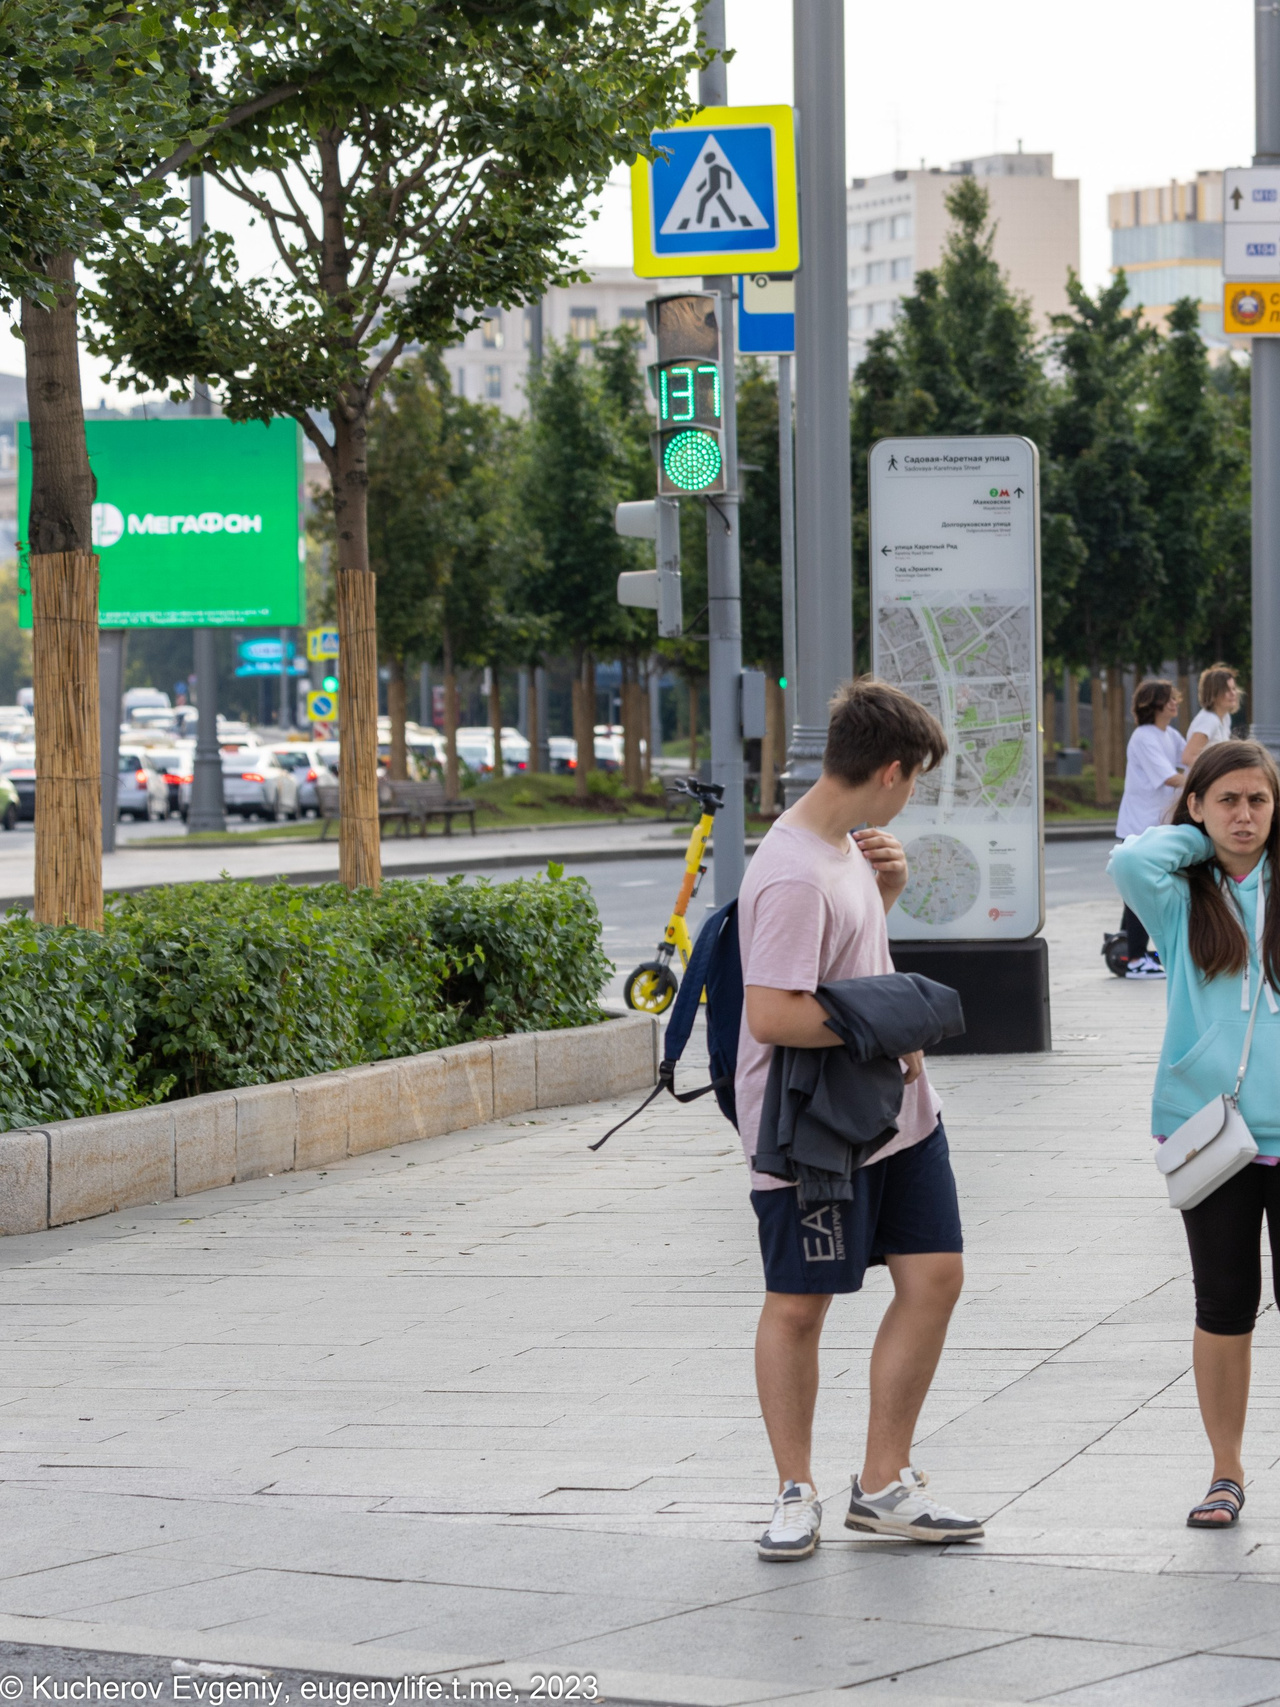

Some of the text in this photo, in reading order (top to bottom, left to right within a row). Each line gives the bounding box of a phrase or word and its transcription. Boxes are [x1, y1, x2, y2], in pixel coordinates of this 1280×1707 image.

[661, 366, 720, 420] 137
[904, 455, 1010, 464] Садовая-Каретная улица
[941, 521, 992, 529] Долгоруковская
